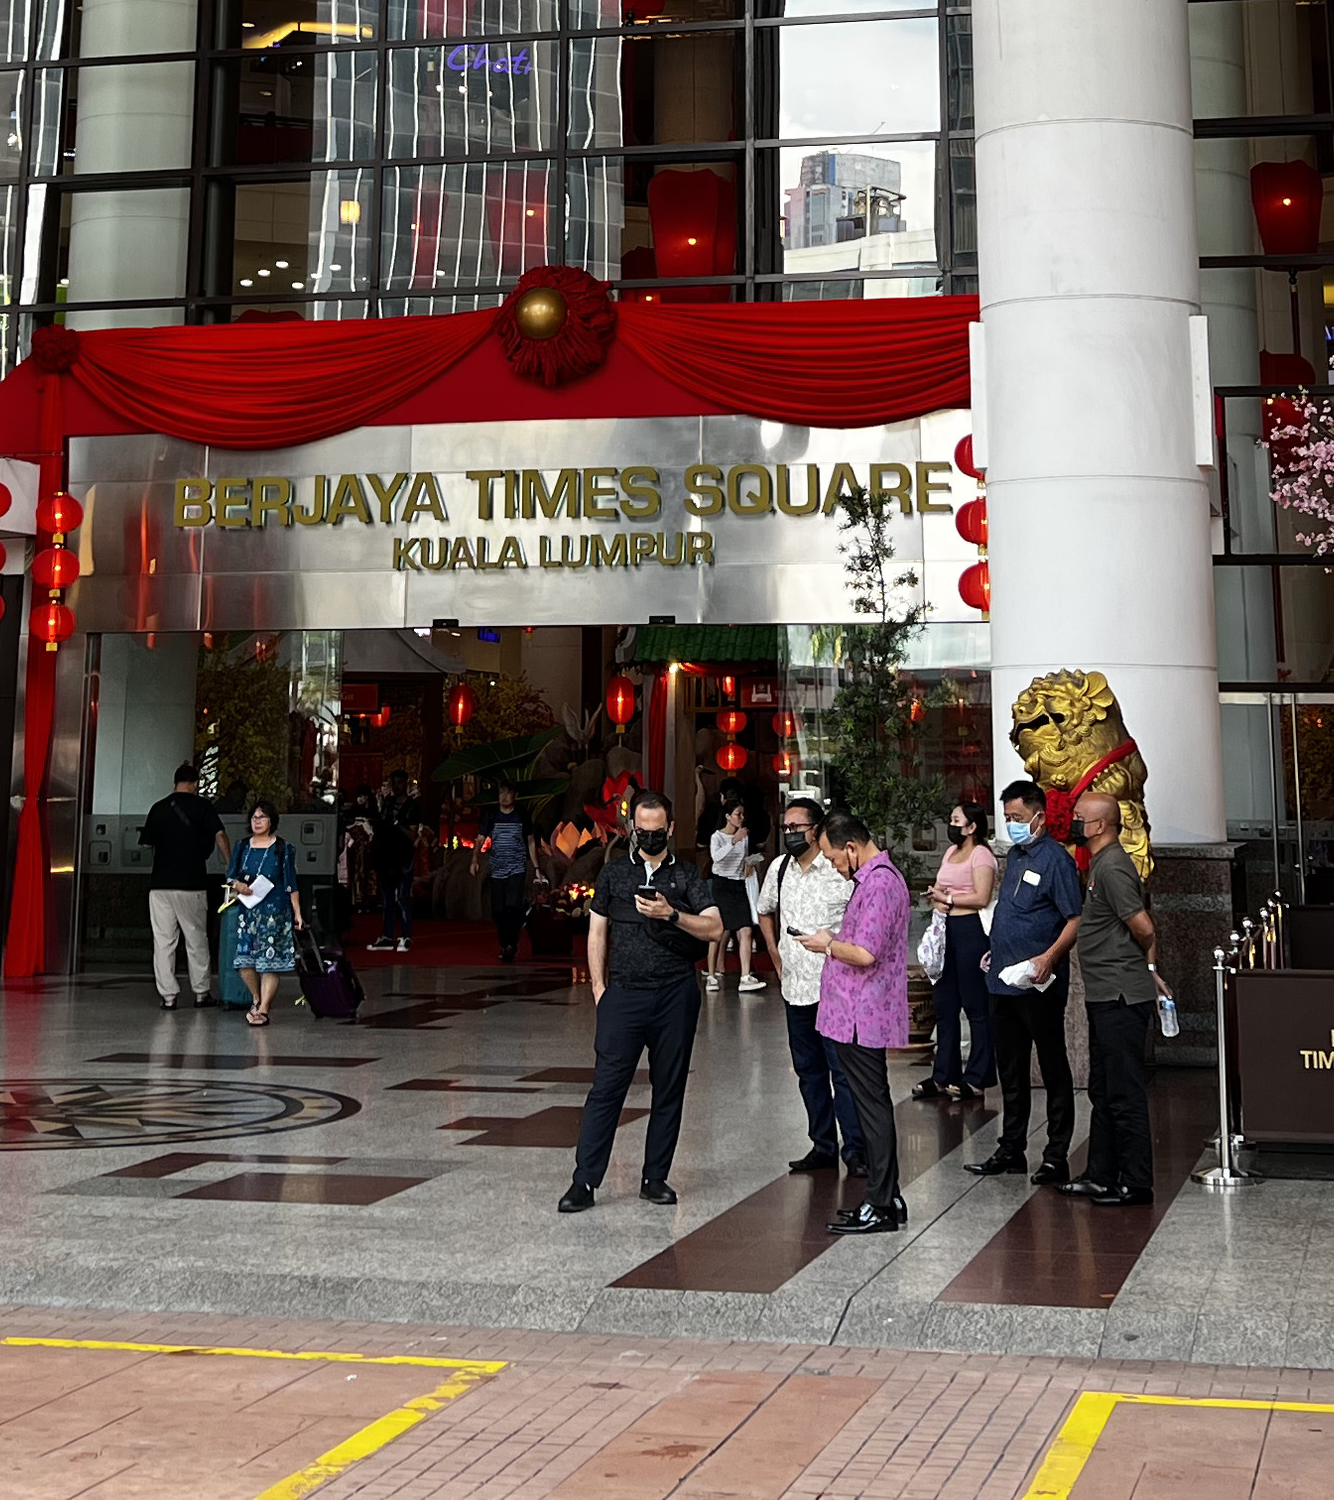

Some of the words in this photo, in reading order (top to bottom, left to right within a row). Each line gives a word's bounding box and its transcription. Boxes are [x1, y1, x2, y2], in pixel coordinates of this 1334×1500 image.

[173, 472, 447, 528] BERJAYA
[466, 466, 662, 520] TIMES
[683, 461, 953, 517] SQUARE
[393, 536, 527, 570] KUALA
[539, 531, 715, 569] LUMPUR
